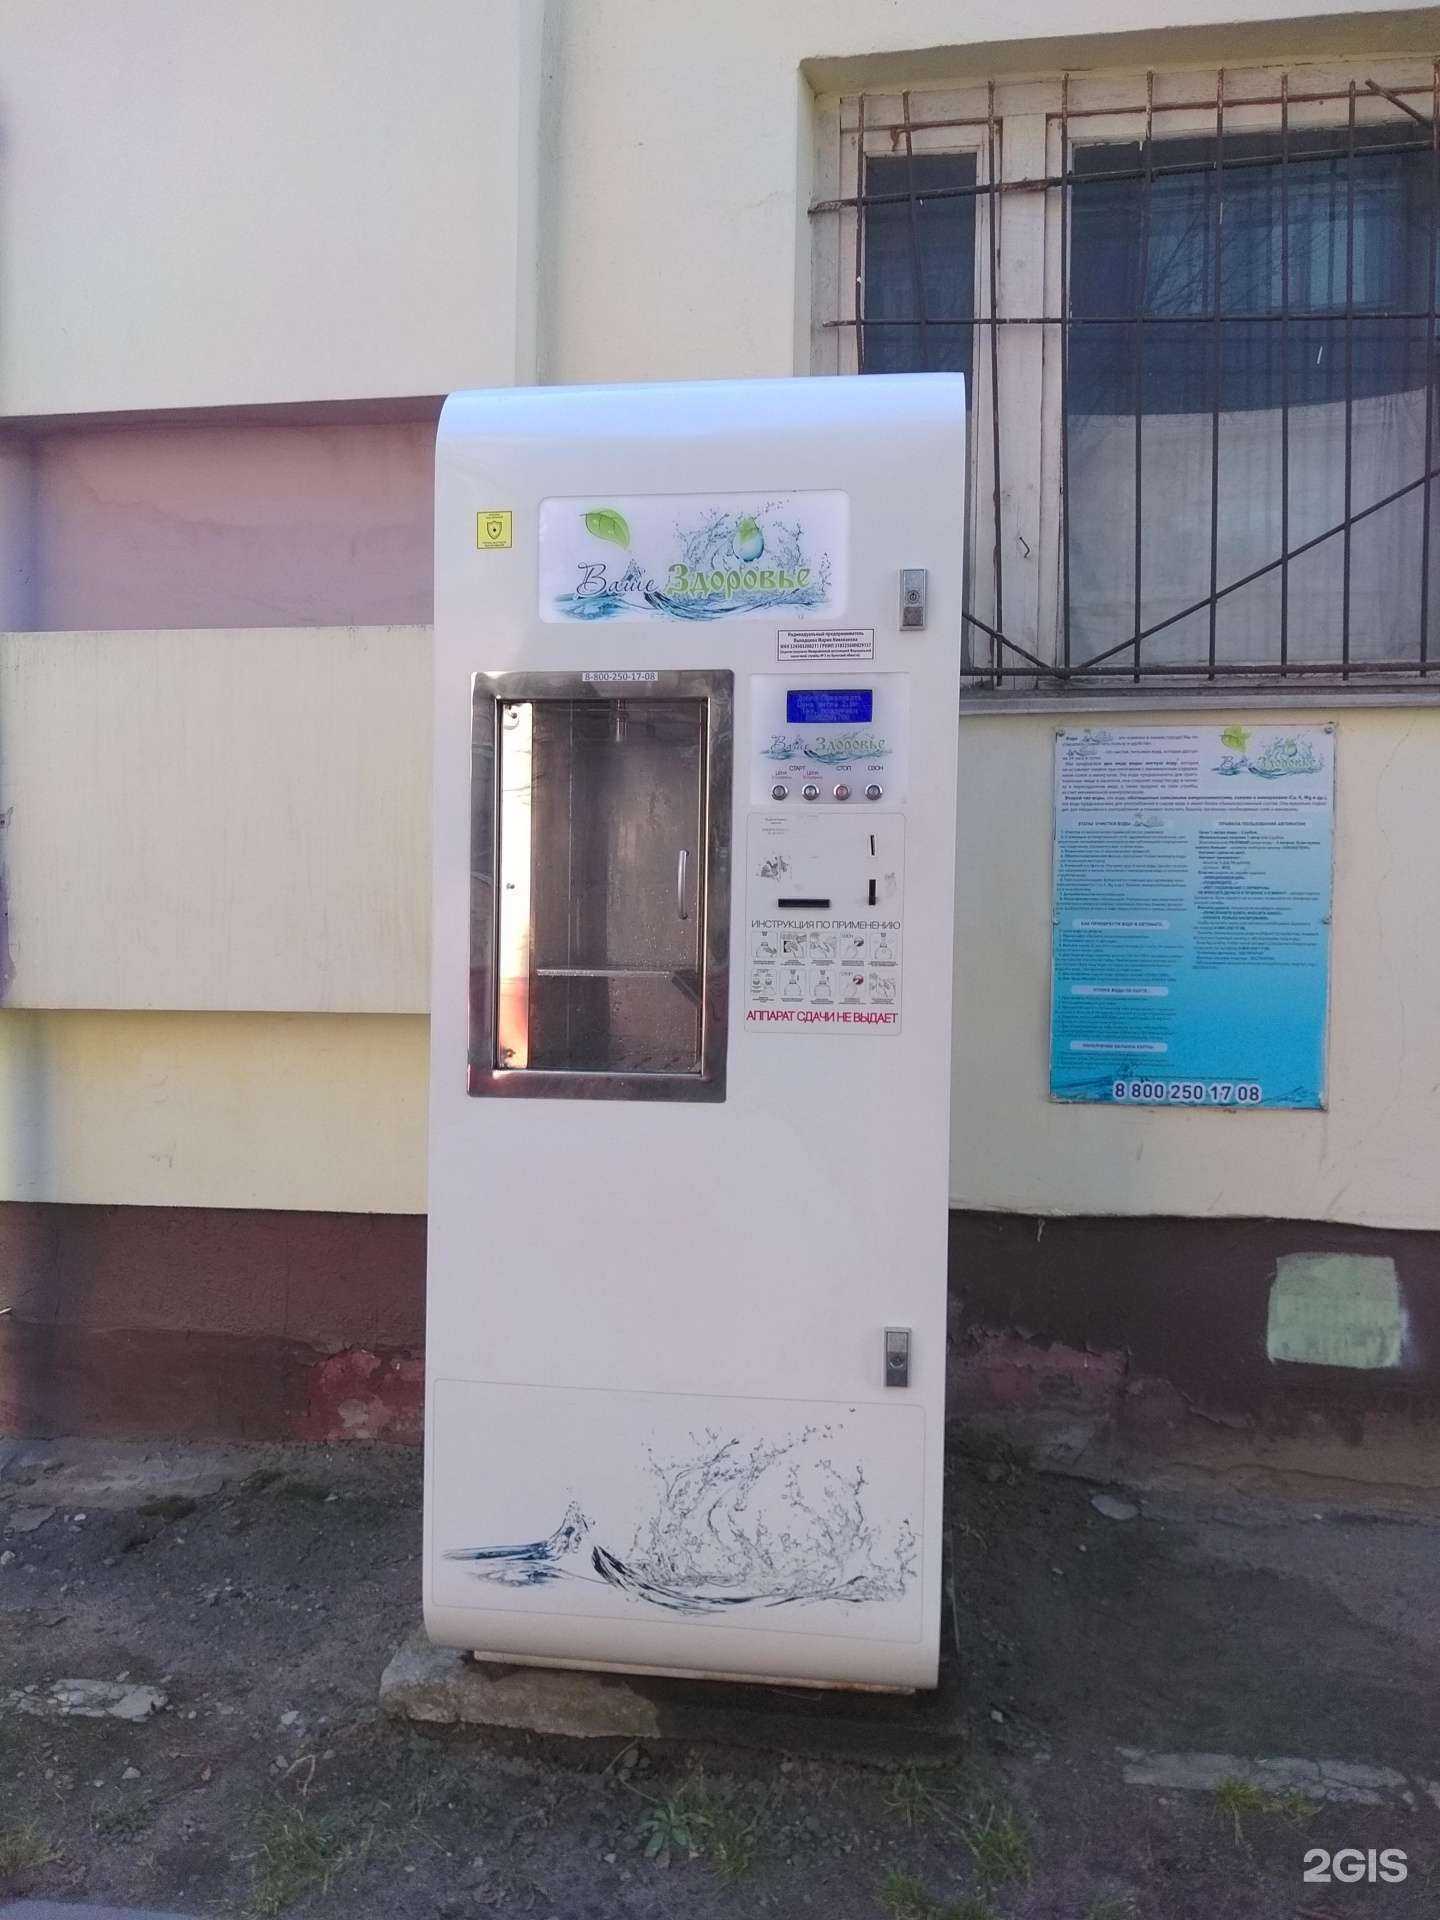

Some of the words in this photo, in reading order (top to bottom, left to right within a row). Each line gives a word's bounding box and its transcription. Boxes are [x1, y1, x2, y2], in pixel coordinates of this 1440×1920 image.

[577, 561, 659, 597] Ваше
[666, 563, 811, 598] Здоровье
[584, 672, 657, 682] 8-800-250-17-08
[751, 920, 815, 929] ИНСТРУКЦИЯ
[815, 920, 831, 929] ПО
[832, 920, 901, 930] ПРИМЕНЕНИЮ
[746, 1011, 796, 1021] АППАРАТ
[797, 1011, 836, 1023] СДАЧИ
[837, 1012, 853, 1022] НЕ
[853, 1012, 898, 1024] ВЫДАЕТ
[1115, 1083, 1125, 1098] 8
[1131, 1083, 1164, 1099] 800
[1170, 1084, 1203, 1100] 250
[1210, 1085, 1232, 1100] 17
[1237, 1086, 1260, 1101] 08
